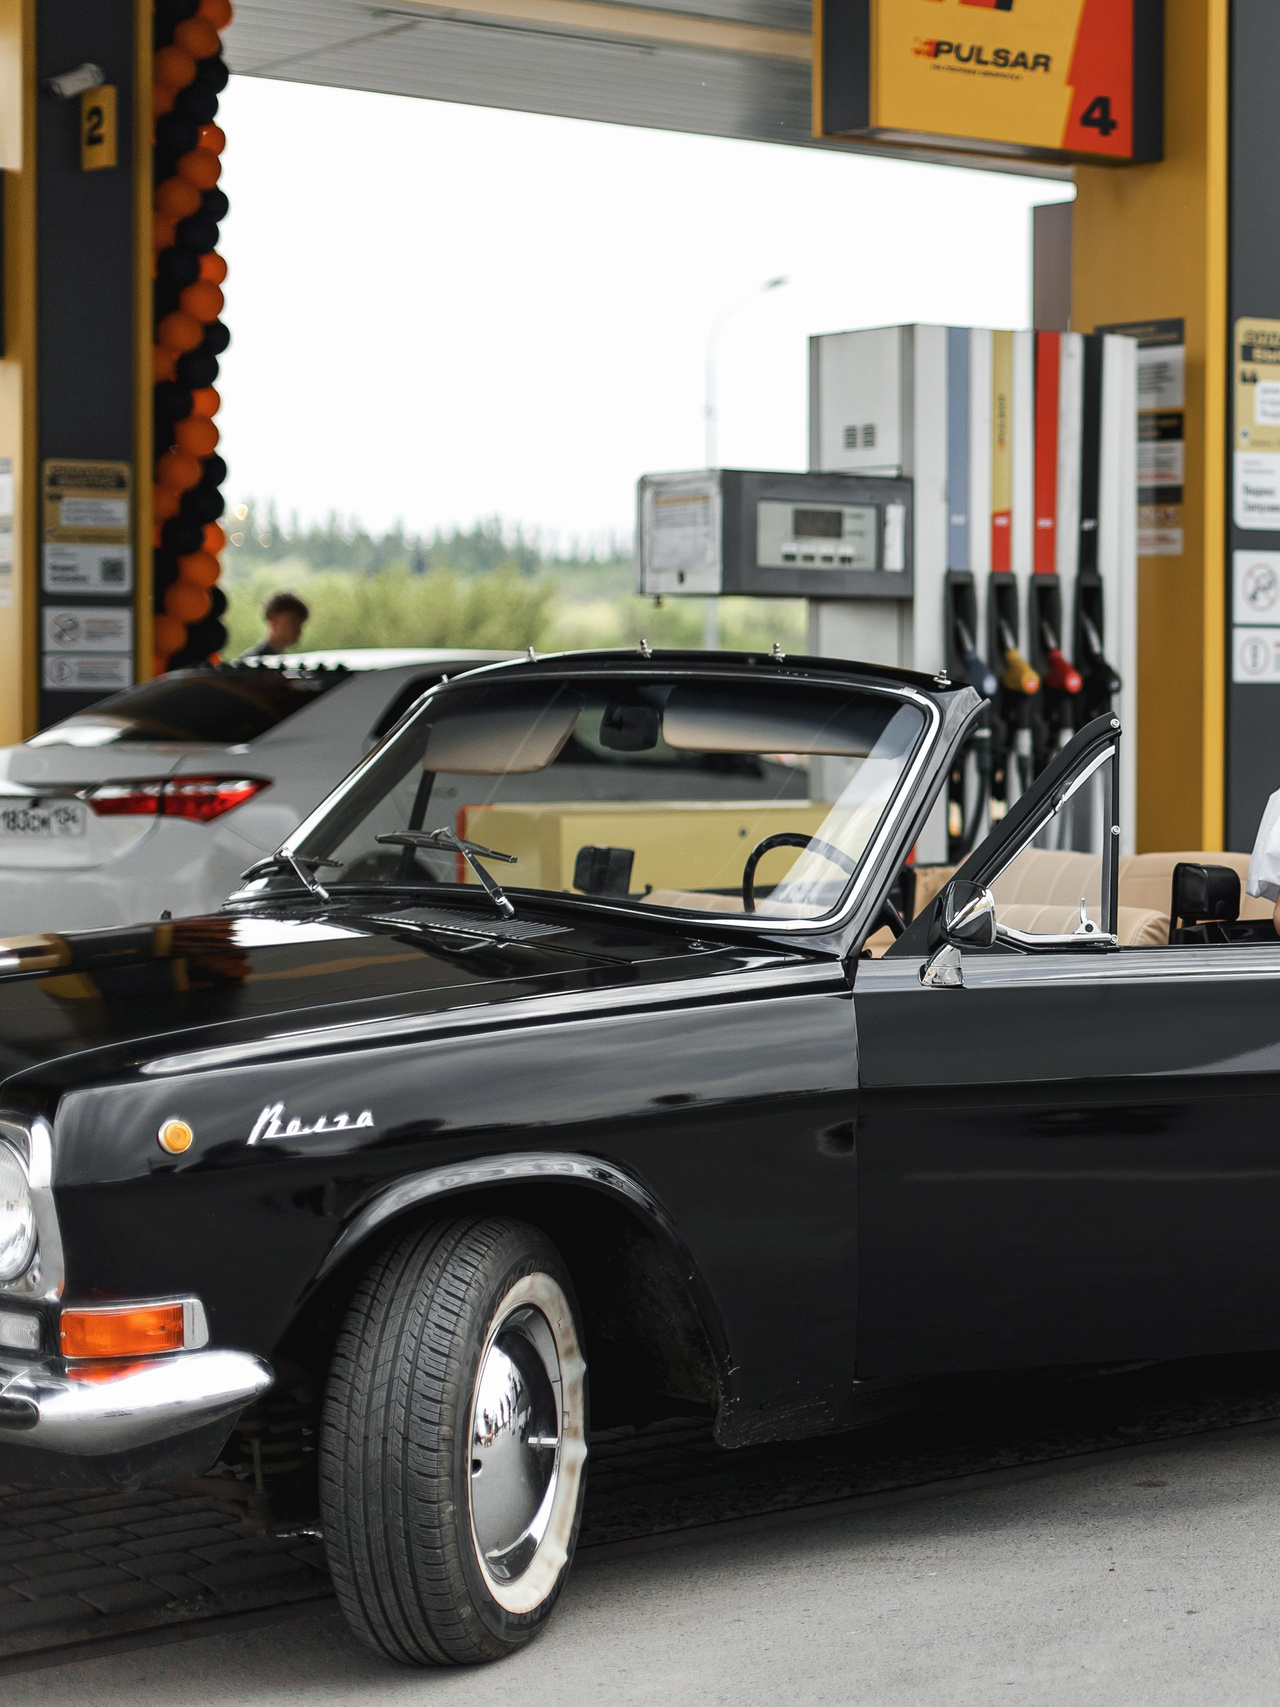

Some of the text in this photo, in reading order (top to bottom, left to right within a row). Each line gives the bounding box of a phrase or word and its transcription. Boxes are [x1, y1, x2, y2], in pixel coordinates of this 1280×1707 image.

[934, 40, 1052, 73] PULSAR
[86, 105, 104, 147] 2
[1080, 95, 1118, 137] 4
